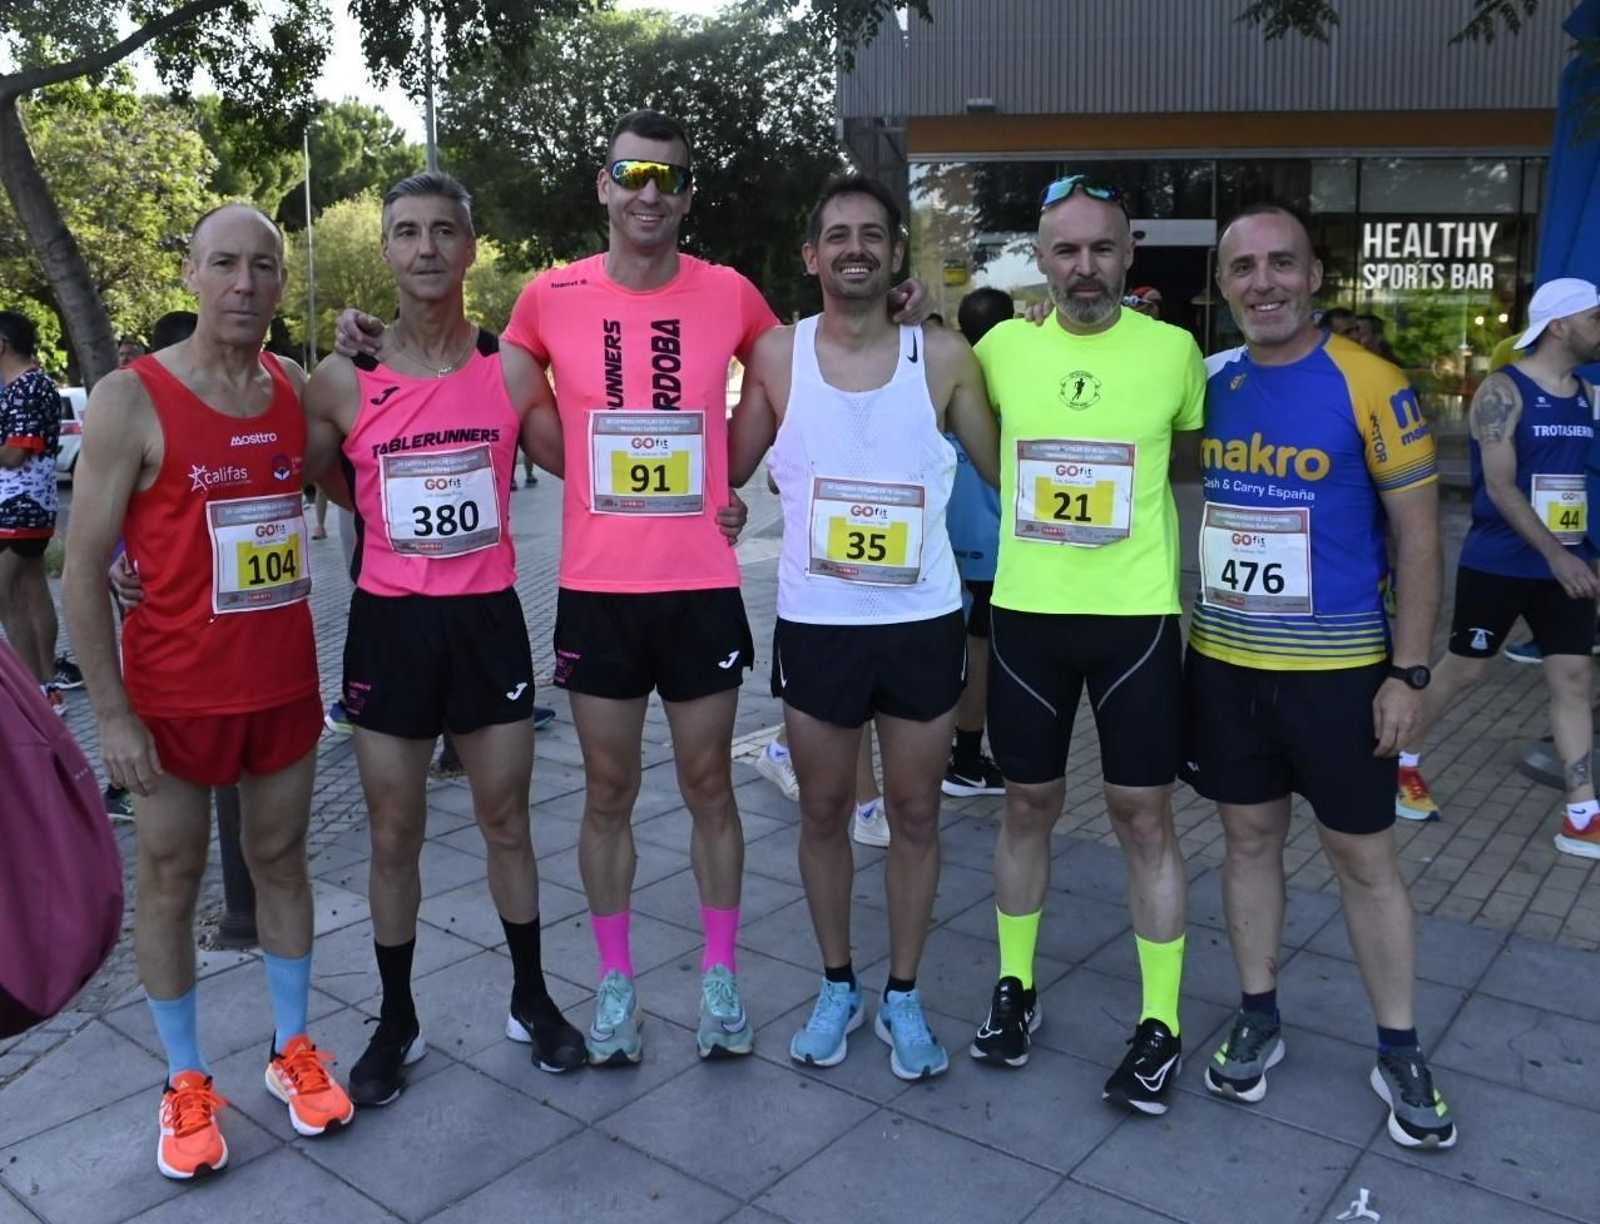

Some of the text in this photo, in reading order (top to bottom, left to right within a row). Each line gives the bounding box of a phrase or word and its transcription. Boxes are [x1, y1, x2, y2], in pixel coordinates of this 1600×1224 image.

[1363, 222, 1498, 258] HEALTHY
[1363, 263, 1494, 290] SPORTS BAR
[603, 318, 625, 410] UNNERS
[204, 466, 248, 484] califas
[630, 464, 671, 493] 91
[1222, 479, 1230, 490] &
[1233, 480, 1265, 497] Carry
[1268, 485, 1315, 501] España
[412, 500, 479, 537] 380
[1053, 491, 1092, 523] 21
[1559, 510, 1580, 529] 44
[846, 531, 887, 562] 35
[247, 548, 296, 586] 104
[1221, 559, 1285, 594] 476
